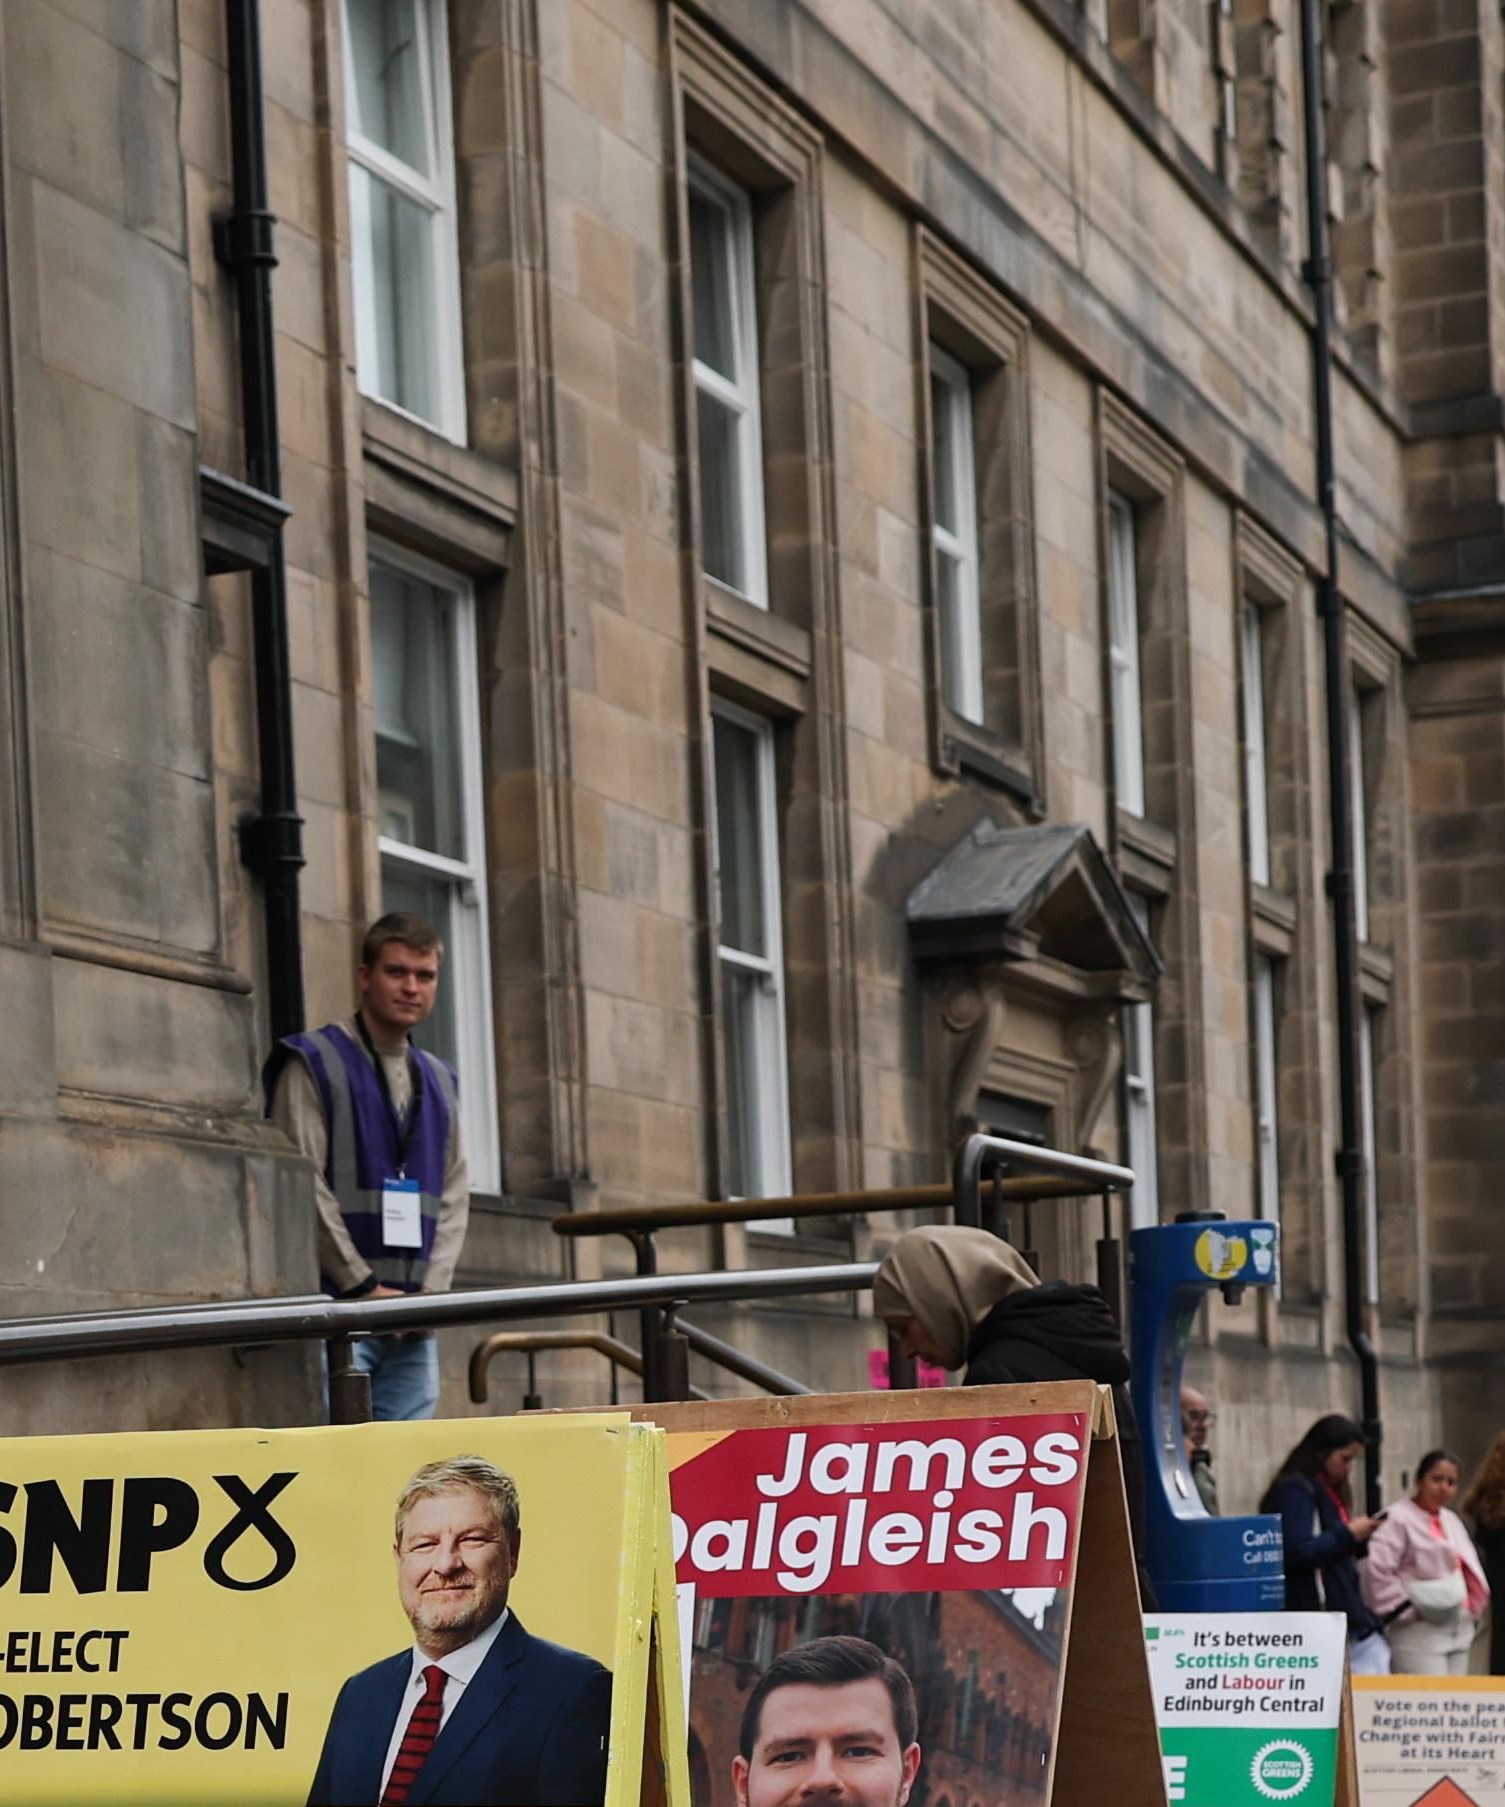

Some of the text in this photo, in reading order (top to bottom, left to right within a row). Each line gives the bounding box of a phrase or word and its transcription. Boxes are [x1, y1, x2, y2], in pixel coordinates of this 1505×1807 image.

[756, 1431, 1081, 1497] James
[1194, 1632, 1220, 1647] It's
[1225, 1632, 1303, 1647] between
[1175, 1652, 1319, 1668] Scottish Greens
[1186, 1674, 1305, 1690] and Labour in
[1164, 1696, 1324, 1714] Edinburgh Central
[1374, 1700, 1412, 1712] Vote
[1418, 1702, 1438, 1712] on
[1444, 1700, 1471, 1712] the
[1372, 1715, 1444, 1729] Regional
[1449, 1715, 1497, 1727] ballot
[1359, 1730, 1421, 1745] Change
[1426, 1731, 1464, 1743] with
[1400, 1748, 1495, 1759] at its Heart
[1262, 1761, 1302, 1778] SCOTTISH GREENS
